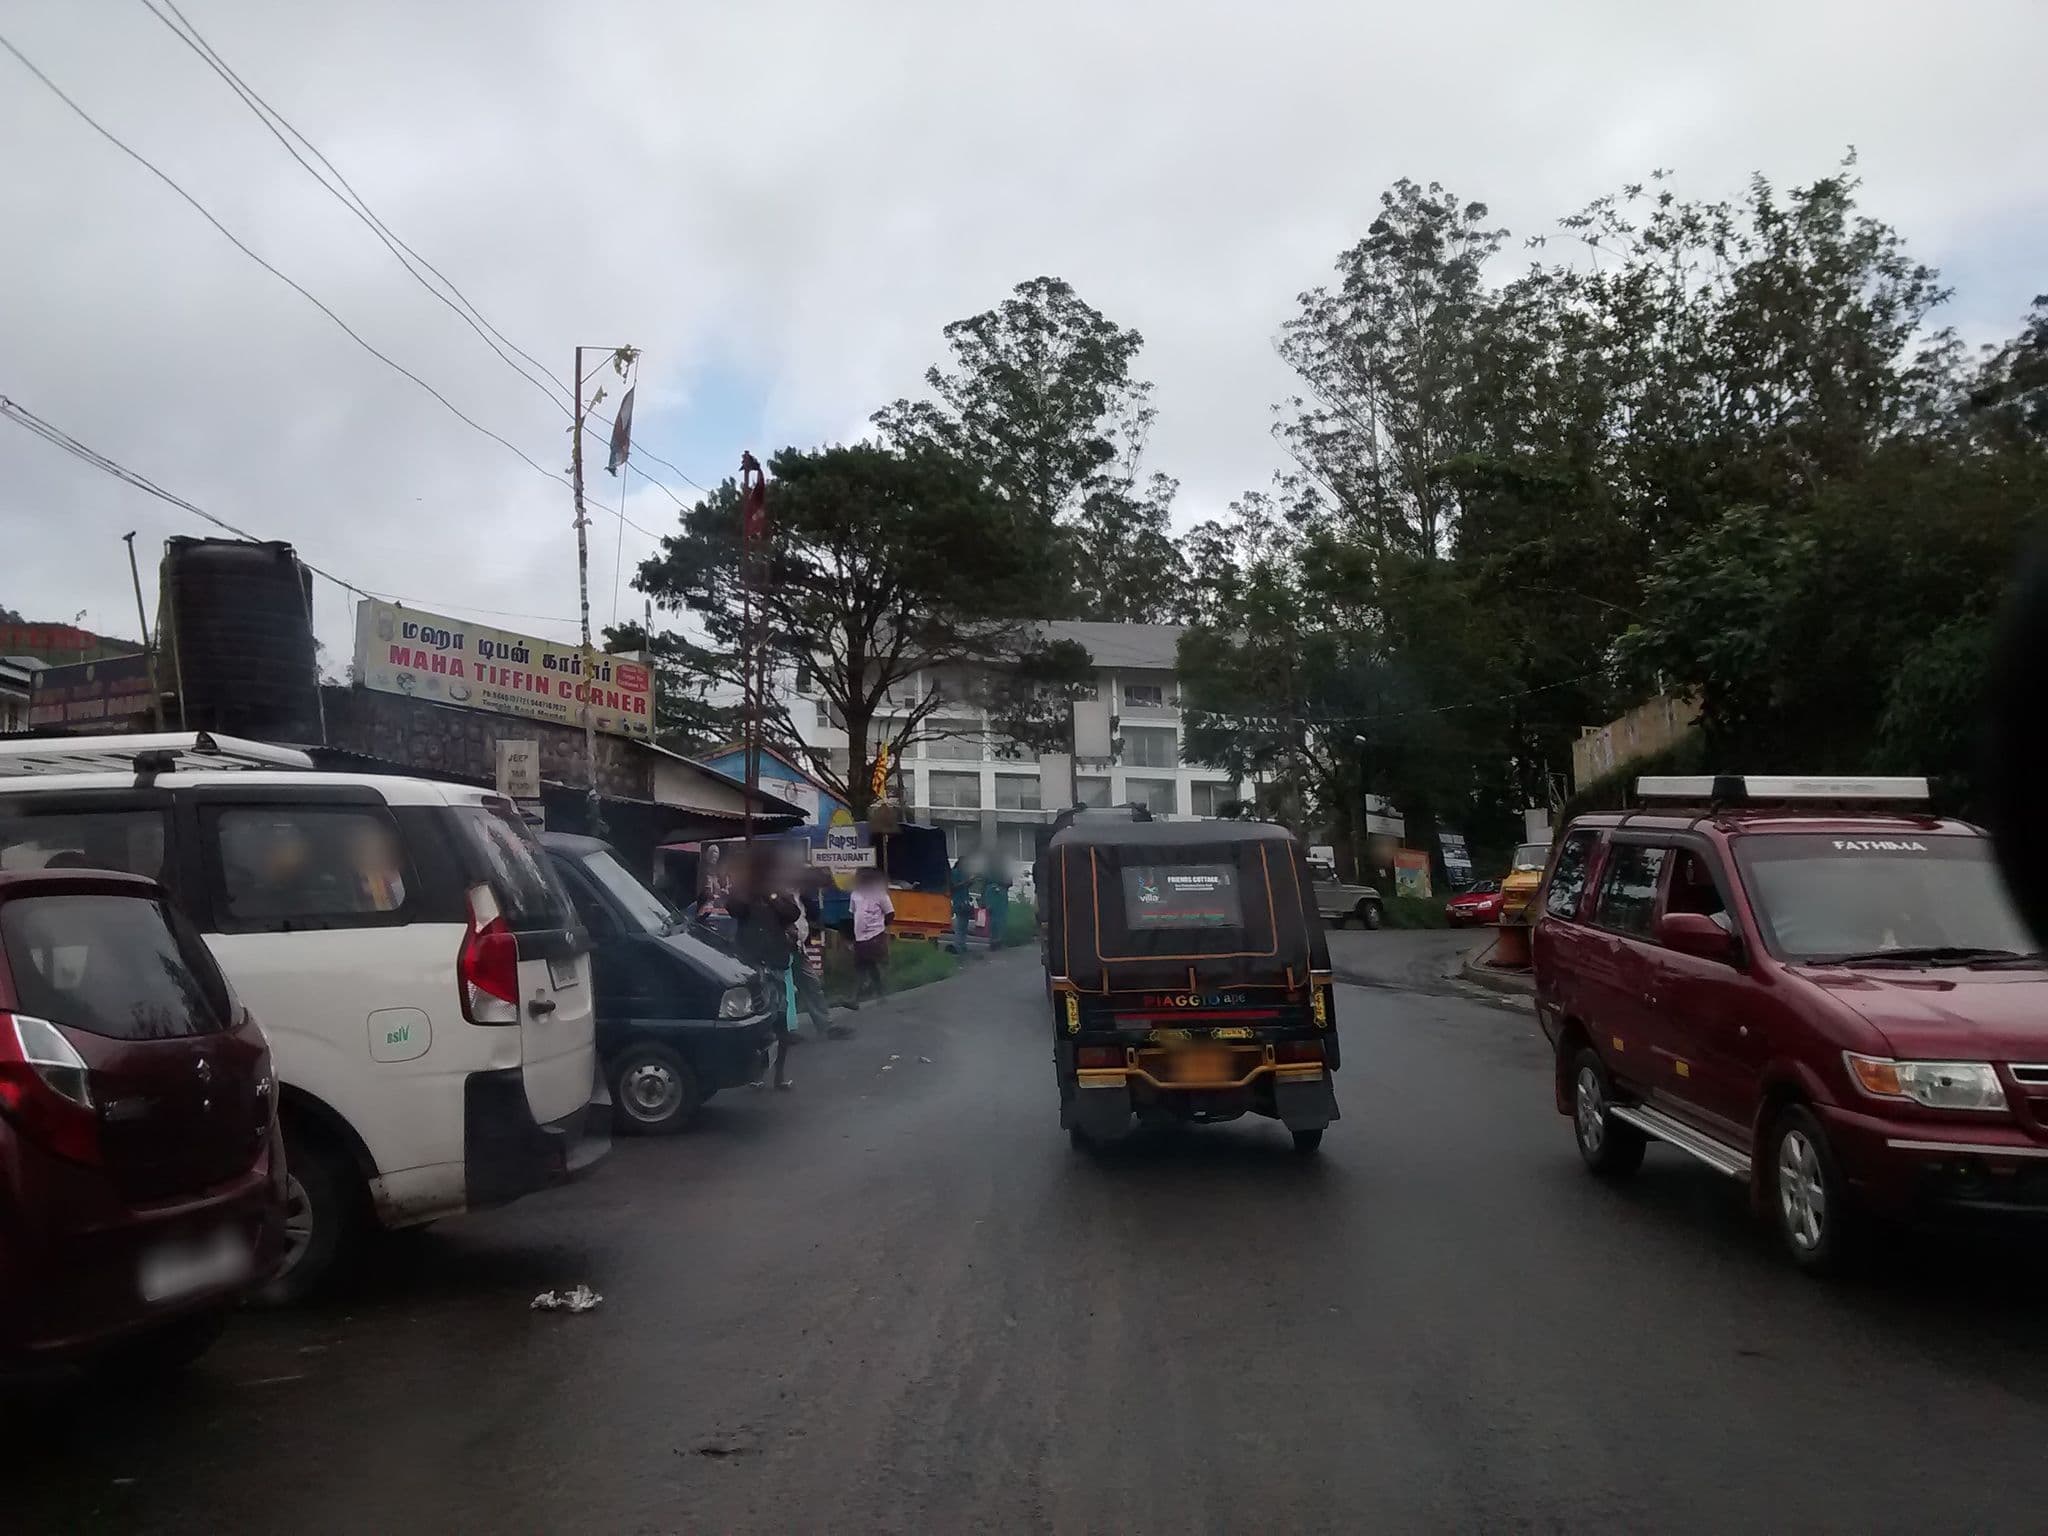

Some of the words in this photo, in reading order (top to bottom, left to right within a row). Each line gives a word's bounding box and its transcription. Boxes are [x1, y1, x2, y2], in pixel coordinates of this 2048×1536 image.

[389, 645, 465, 677] MAHA
[474, 662, 550, 695] TIFFIN
[559, 680, 646, 715] CORNER
[1832, 840, 1928, 851] FATHIMA
[816, 853, 870, 862] RESTAURANT
[1143, 993, 1220, 1007] PIAGGIO
